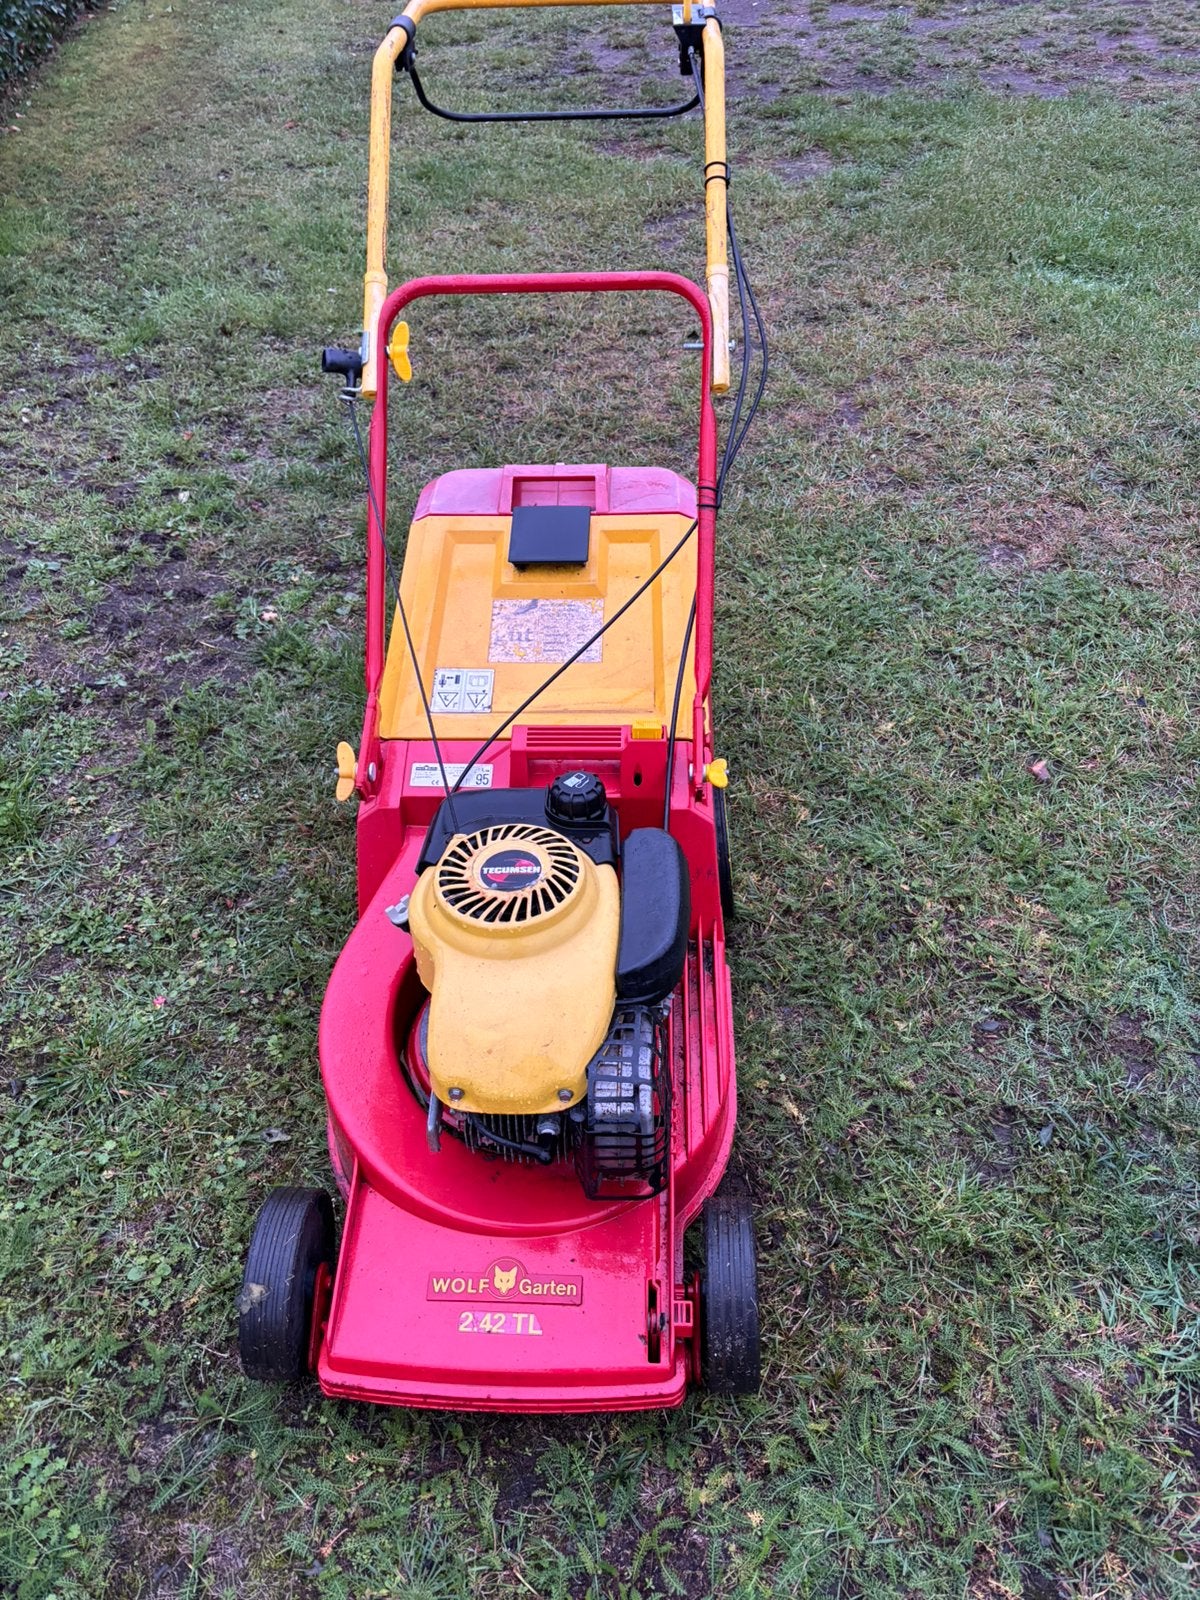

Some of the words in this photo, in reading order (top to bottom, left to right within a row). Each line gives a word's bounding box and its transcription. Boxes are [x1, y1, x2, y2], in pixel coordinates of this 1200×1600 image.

[475, 773, 490, 786] 95
[482, 866, 541, 875] TECUMSEH
[432, 1277, 490, 1294] WOLF
[518, 1278, 577, 1296] Garten
[458, 1311, 506, 1333] 2.42
[512, 1313, 543, 1335] TL
